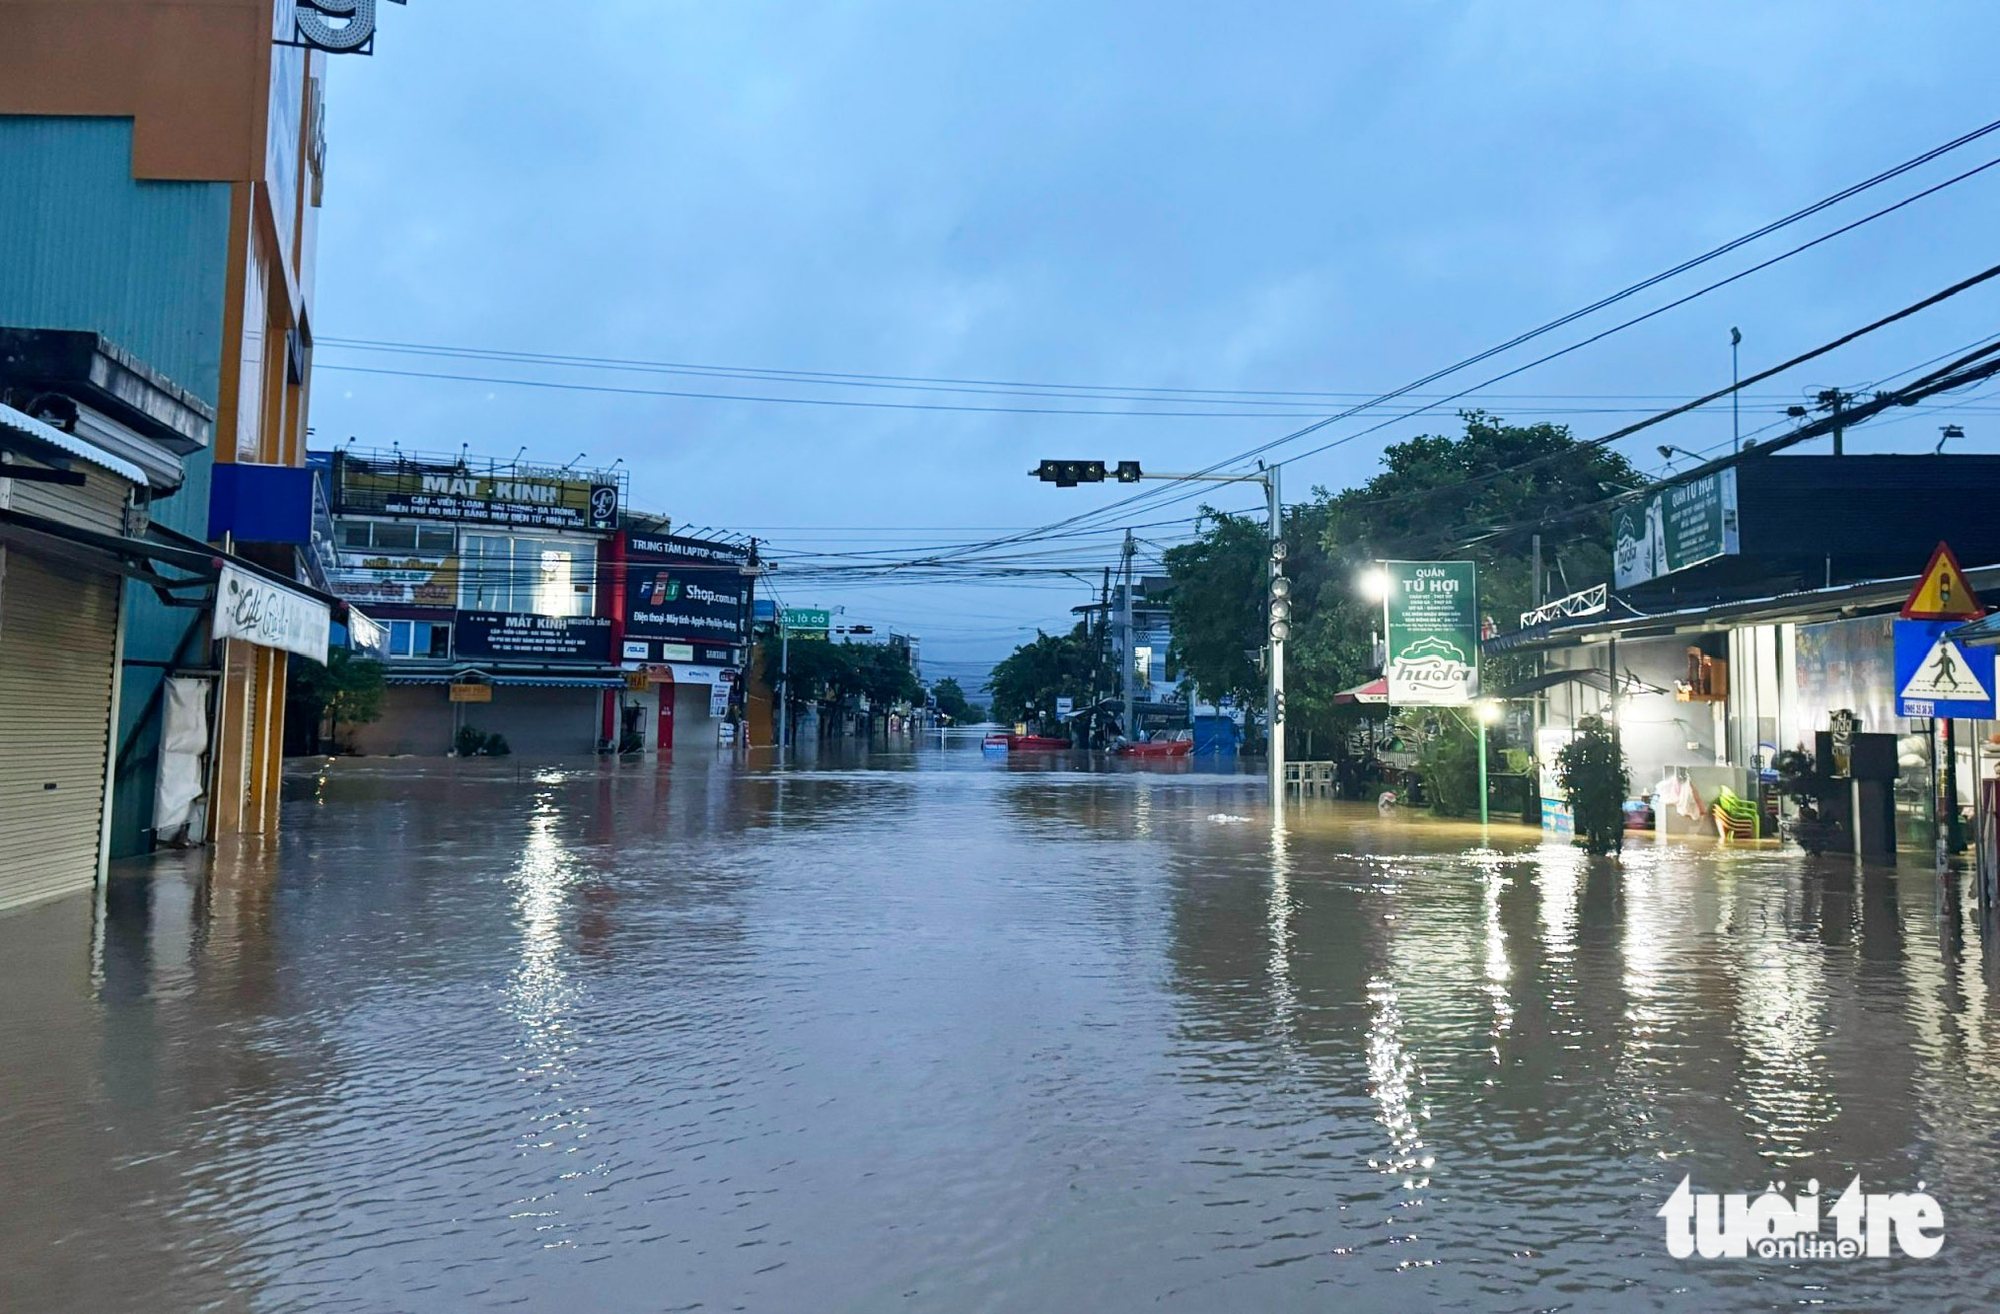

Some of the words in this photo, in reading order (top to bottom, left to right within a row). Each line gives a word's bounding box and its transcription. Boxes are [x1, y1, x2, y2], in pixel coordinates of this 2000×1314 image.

[632, 539, 663, 553] TRUNG
[1416, 568, 1446, 578] QUÁN
[1402, 578, 1425, 592] TÚ
[1429, 578, 1460, 595] HỢI
[1396, 659, 1471, 682] huda
